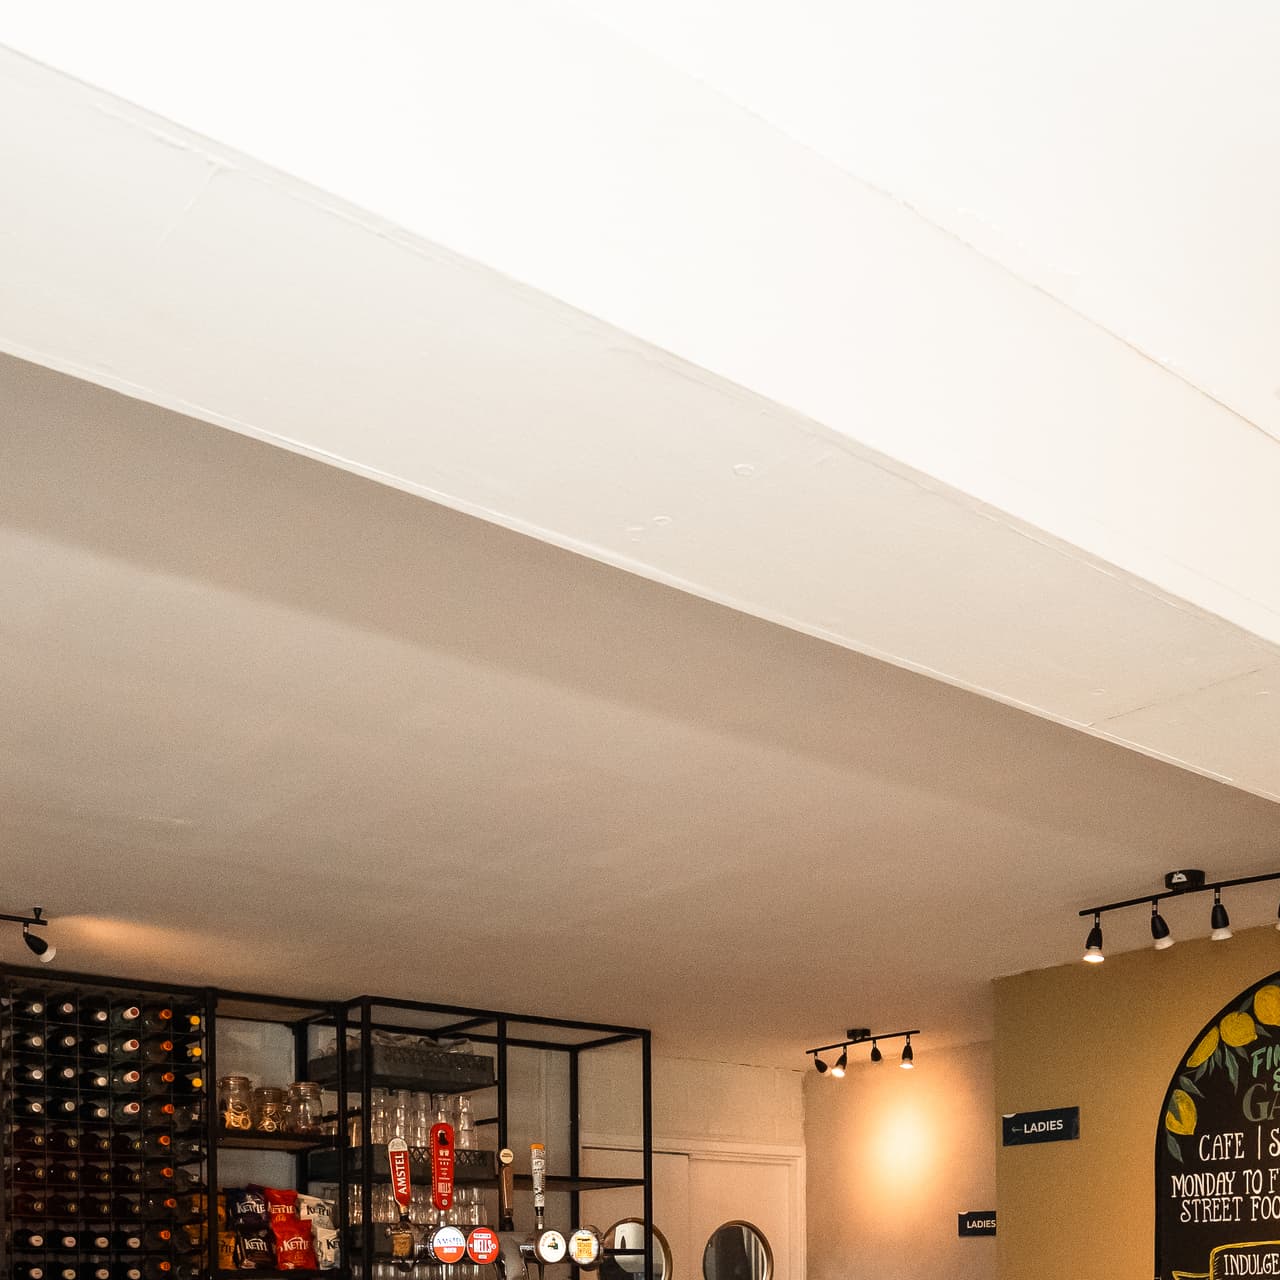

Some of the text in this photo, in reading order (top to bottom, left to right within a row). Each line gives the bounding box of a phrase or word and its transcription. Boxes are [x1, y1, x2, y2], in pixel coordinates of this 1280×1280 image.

[1023, 1119, 1063, 1134] LADIES
[1198, 1132, 1245, 1162] CAFE
[396, 1152, 408, 1195] AMSTEL
[1170, 1170, 1237, 1198] MONDAY
[1243, 1168, 1263, 1195] TO
[236, 1200, 266, 1214] KETTLE
[1179, 1196, 1244, 1223] STREET
[966, 1219, 997, 1230] LADIES
[1224, 1253, 1280, 1276] INDULGE
